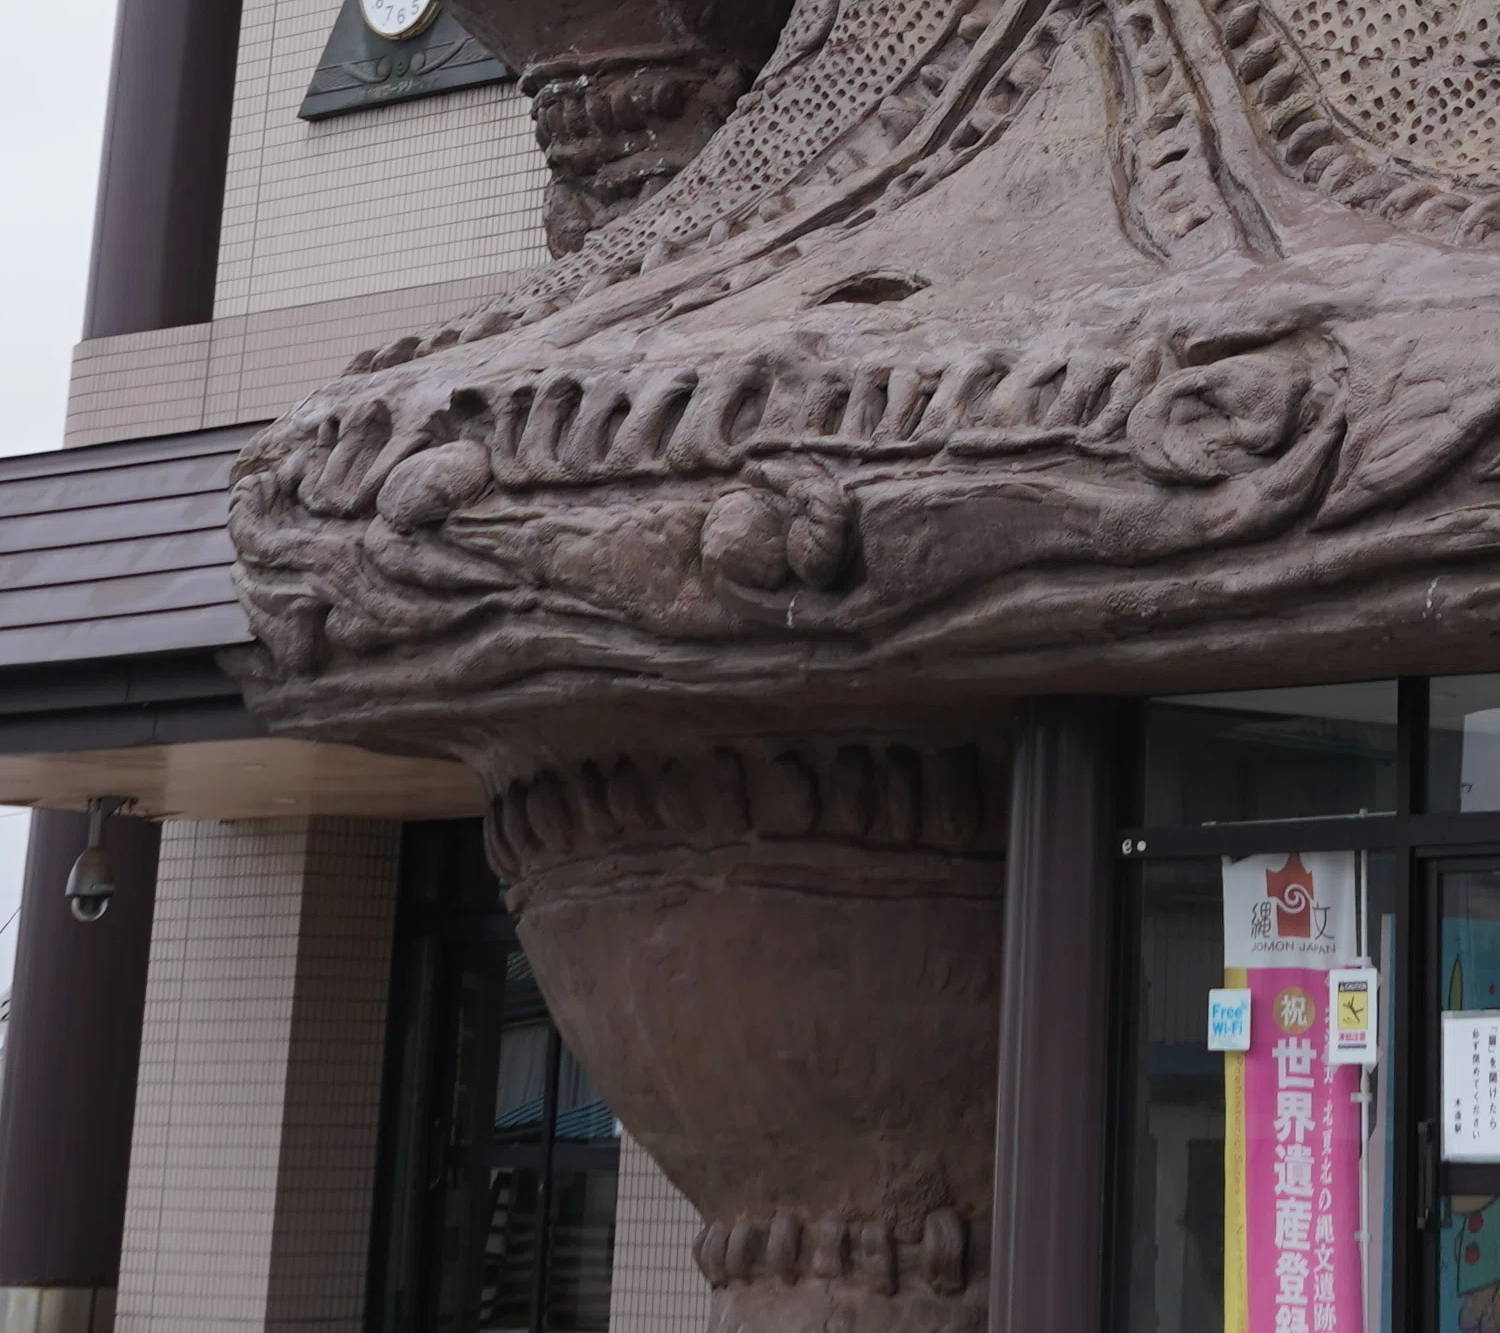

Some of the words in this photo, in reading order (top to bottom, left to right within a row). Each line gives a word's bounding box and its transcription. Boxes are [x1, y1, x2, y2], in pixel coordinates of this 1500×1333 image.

[385, 5, 395, 22] 7
[396, 8, 407, 25] 6
[1251, 941, 1295, 953] JOMON
[1299, 942, 1336, 954] JAPAN
[1212, 1003, 1243, 1020] Free
[1280, 994, 1308, 1027] 祝
[1212, 1020, 1243, 1036] Wi-Fi
